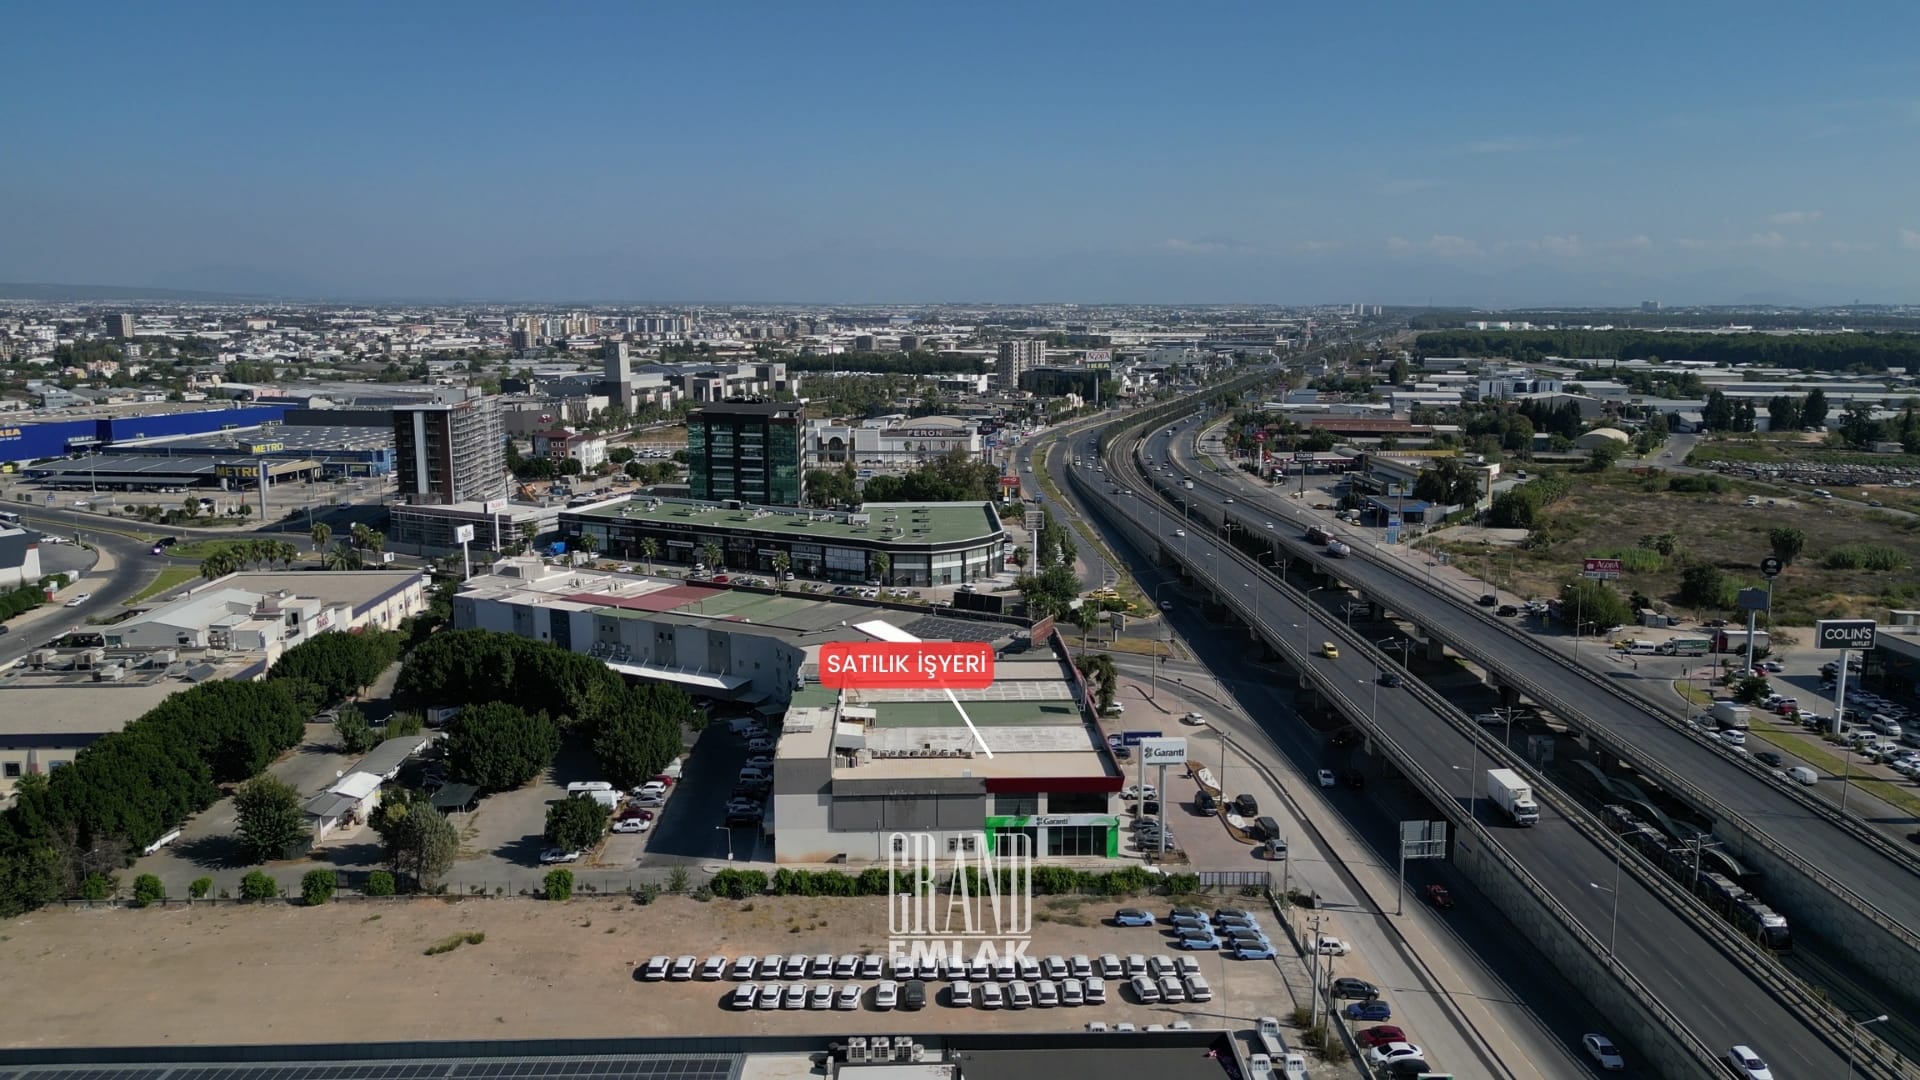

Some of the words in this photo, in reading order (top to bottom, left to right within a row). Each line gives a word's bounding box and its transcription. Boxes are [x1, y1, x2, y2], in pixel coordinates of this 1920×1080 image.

[0, 428, 21, 437] KEA
[252, 443, 283, 454] METRO
[1825, 627, 1872, 640] COLIN'S
[1154, 748, 1185, 757] Garanti
